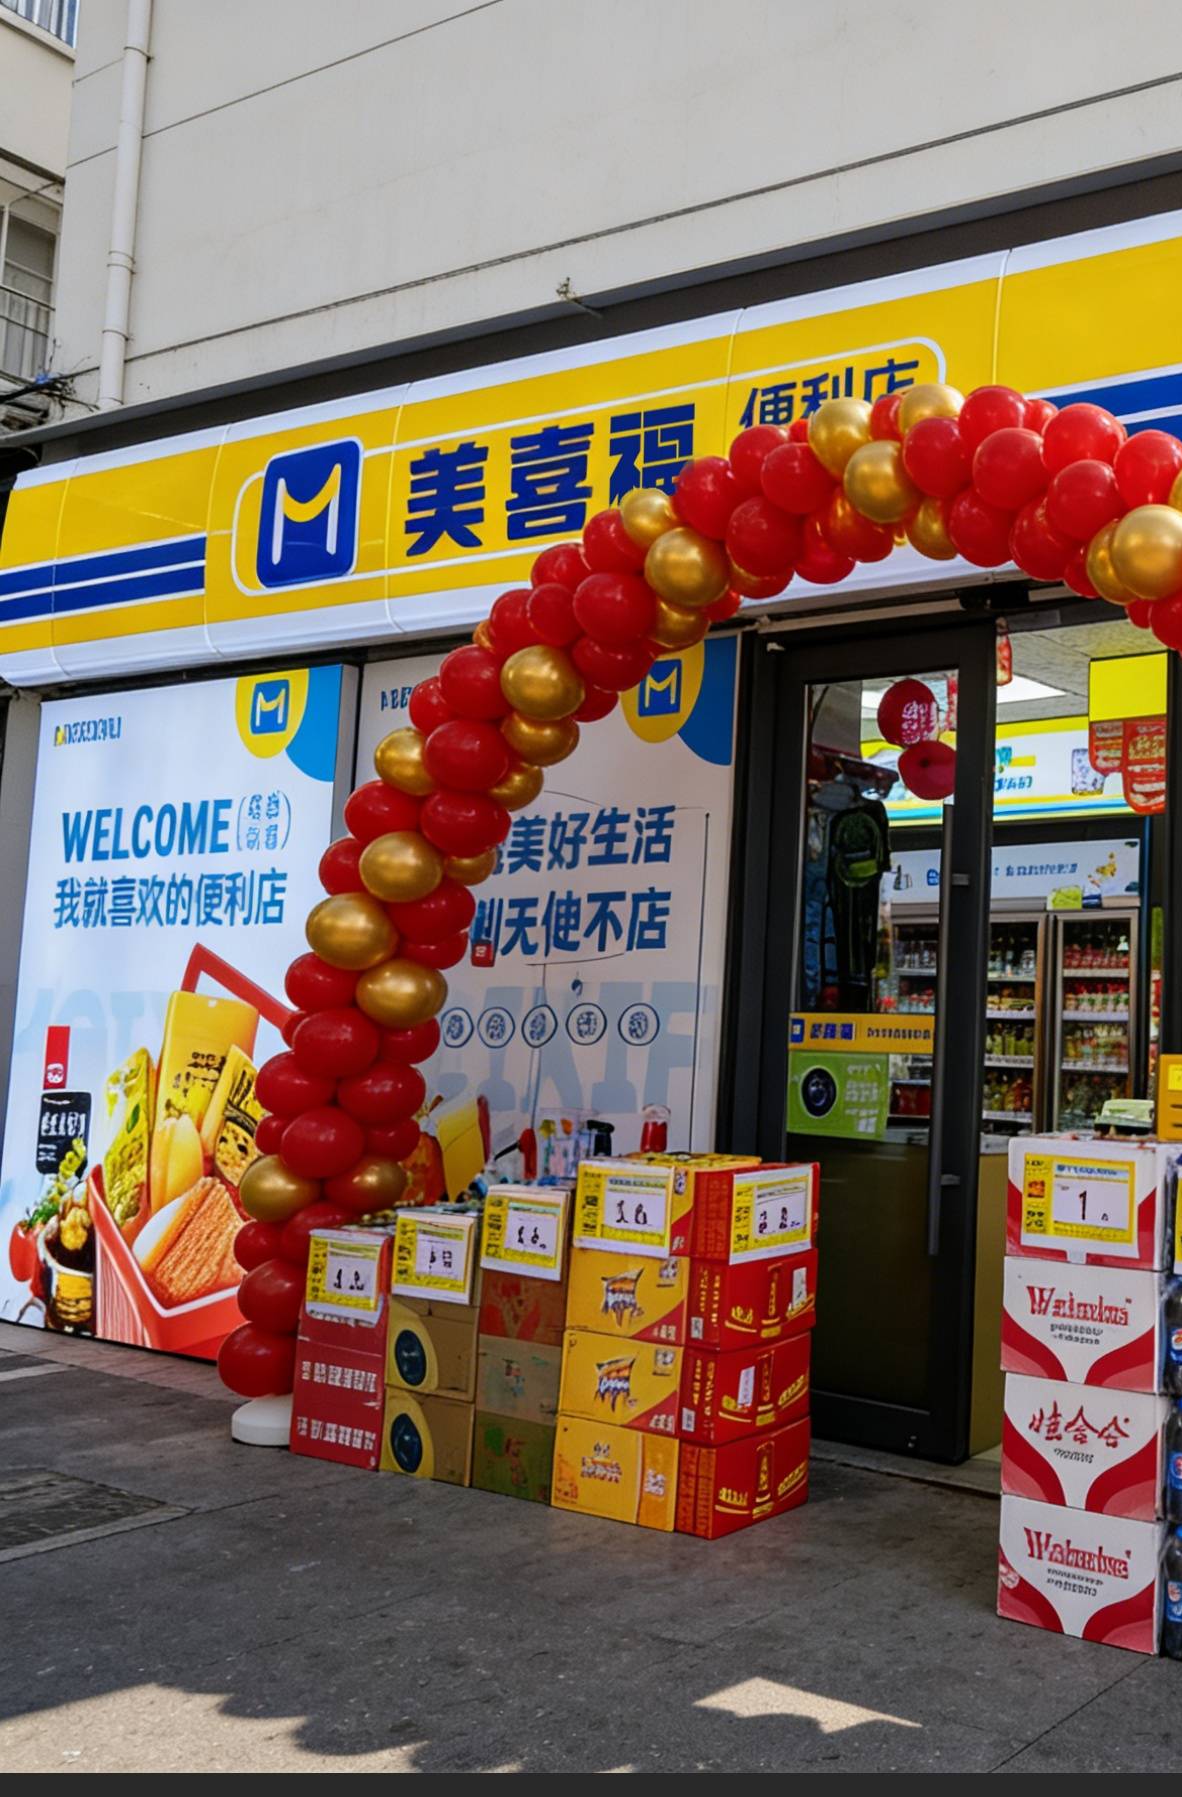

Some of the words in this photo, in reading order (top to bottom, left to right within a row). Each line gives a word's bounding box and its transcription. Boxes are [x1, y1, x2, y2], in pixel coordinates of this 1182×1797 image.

[405, 403, 696, 557] 美喜福
[62, 798, 233, 864] WELCOME
[54, 867, 289, 929] 我就喜欢的便利店
